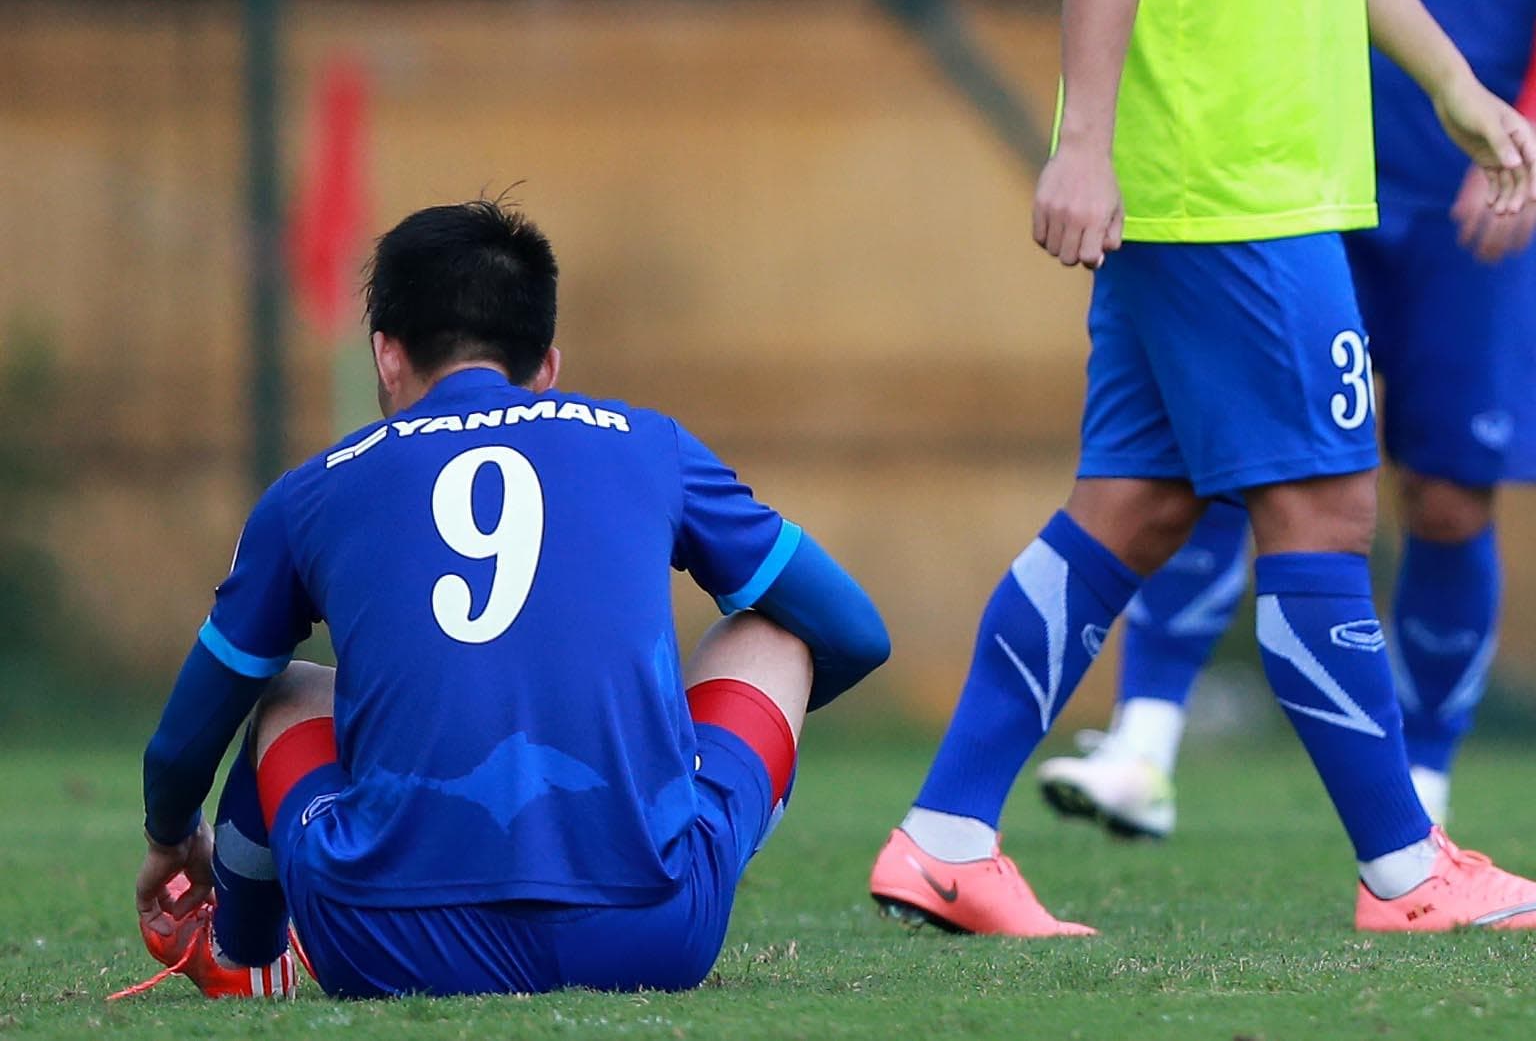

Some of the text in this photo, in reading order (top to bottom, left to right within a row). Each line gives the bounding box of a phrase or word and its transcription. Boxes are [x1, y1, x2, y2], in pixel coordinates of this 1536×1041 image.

[392, 400, 631, 437] YANMAR
[1331, 329, 1376, 430] 3
[431, 445, 545, 644] 9
